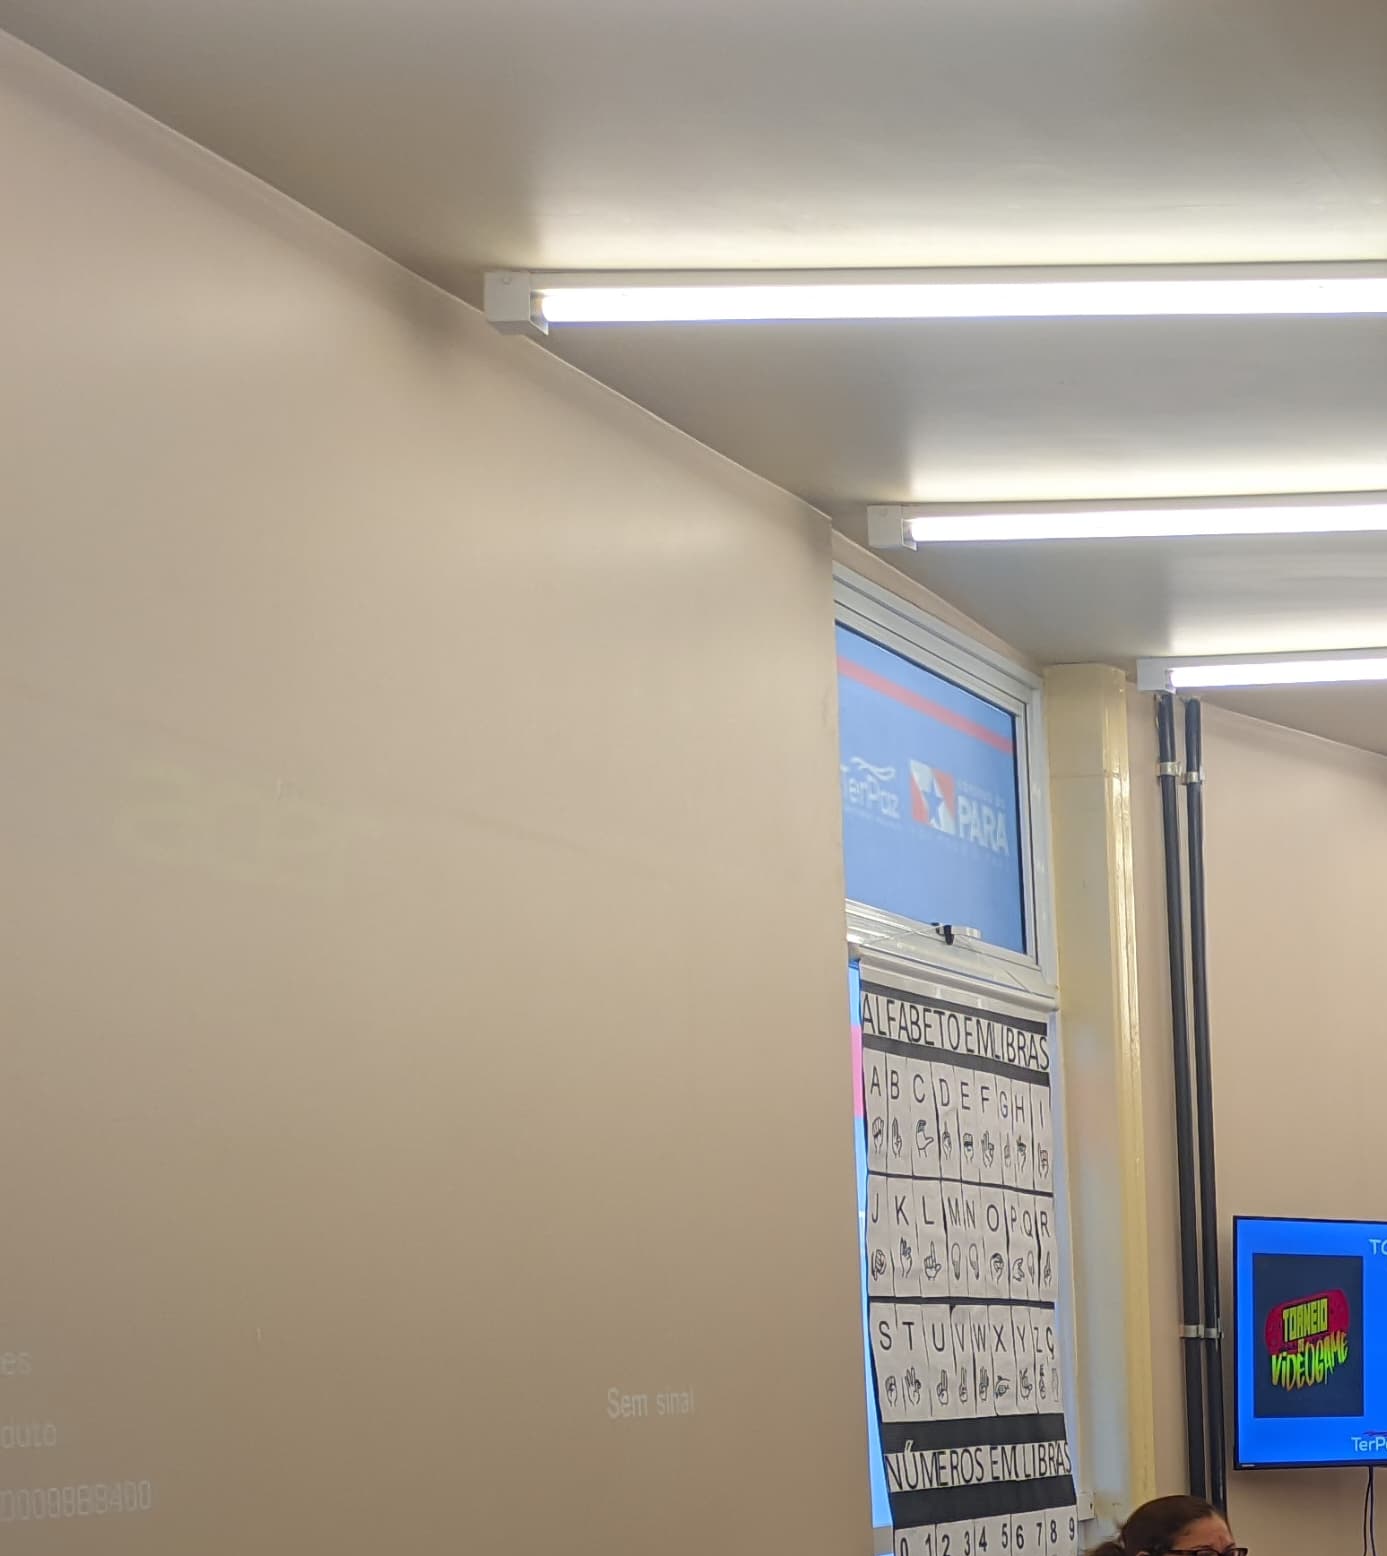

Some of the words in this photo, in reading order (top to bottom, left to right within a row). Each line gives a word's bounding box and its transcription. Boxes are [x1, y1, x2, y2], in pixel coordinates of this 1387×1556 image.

[862, 992, 960, 1052] ALFABETO
[966, 1016, 995, 1058] EM
[994, 1029, 1050, 1072] LIBRAS
[870, 1066, 881, 1097] A
[891, 1070, 900, 1100] B
[913, 1073, 926, 1103] C
[940, 1078, 950, 1107] D
[961, 1082, 971, 1110] E
[980, 1086, 990, 1113] F
[1000, 1091, 1009, 1119] G
[1015, 1095, 1025, 1124] H
[1039, 1102, 1045, 1129] I
[871, 1193, 880, 1224] J
[896, 1196, 909, 1225] K
[922, 1196, 935, 1225] L
[949, 1197, 961, 1227] M
[965, 1198, 976, 1229] N
[986, 1203, 999, 1232] O
[1010, 1206, 1017, 1234] P
[1023, 1207, 1033, 1240] Q
[1040, 1210, 1051, 1238] R
[879, 1320, 892, 1350] S
[902, 1321, 915, 1352] T
[932, 1323, 945, 1352] U
[955, 1324, 965, 1352] V
[973, 1323, 987, 1352] W
[993, 1324, 1007, 1352] X
[1017, 1326, 1026, 1351] Y
[1034, 1326, 1042, 1352] Z
[1046, 1326, 1055, 1360] Ç
[1283, 1297, 1328, 1342] TORNEIO
[607, 1386, 648, 1419] Sem
[655, 1384, 694, 1417] sinal
[885, 1439, 984, 1490] NÚMEROS
[992, 1446, 1017, 1479] EM
[1024, 1440, 1073, 1478] LIBRAS
[964, 1531, 971, 1556] 3
[979, 1525, 988, 1552] 4
[1001, 1522, 1009, 1549] 5
[1016, 1523, 1024, 1549] 6
[1036, 1521, 1043, 1547] 7
[1050, 1519, 1058, 1544] 8
[1069, 1516, 1075, 1542] 9
